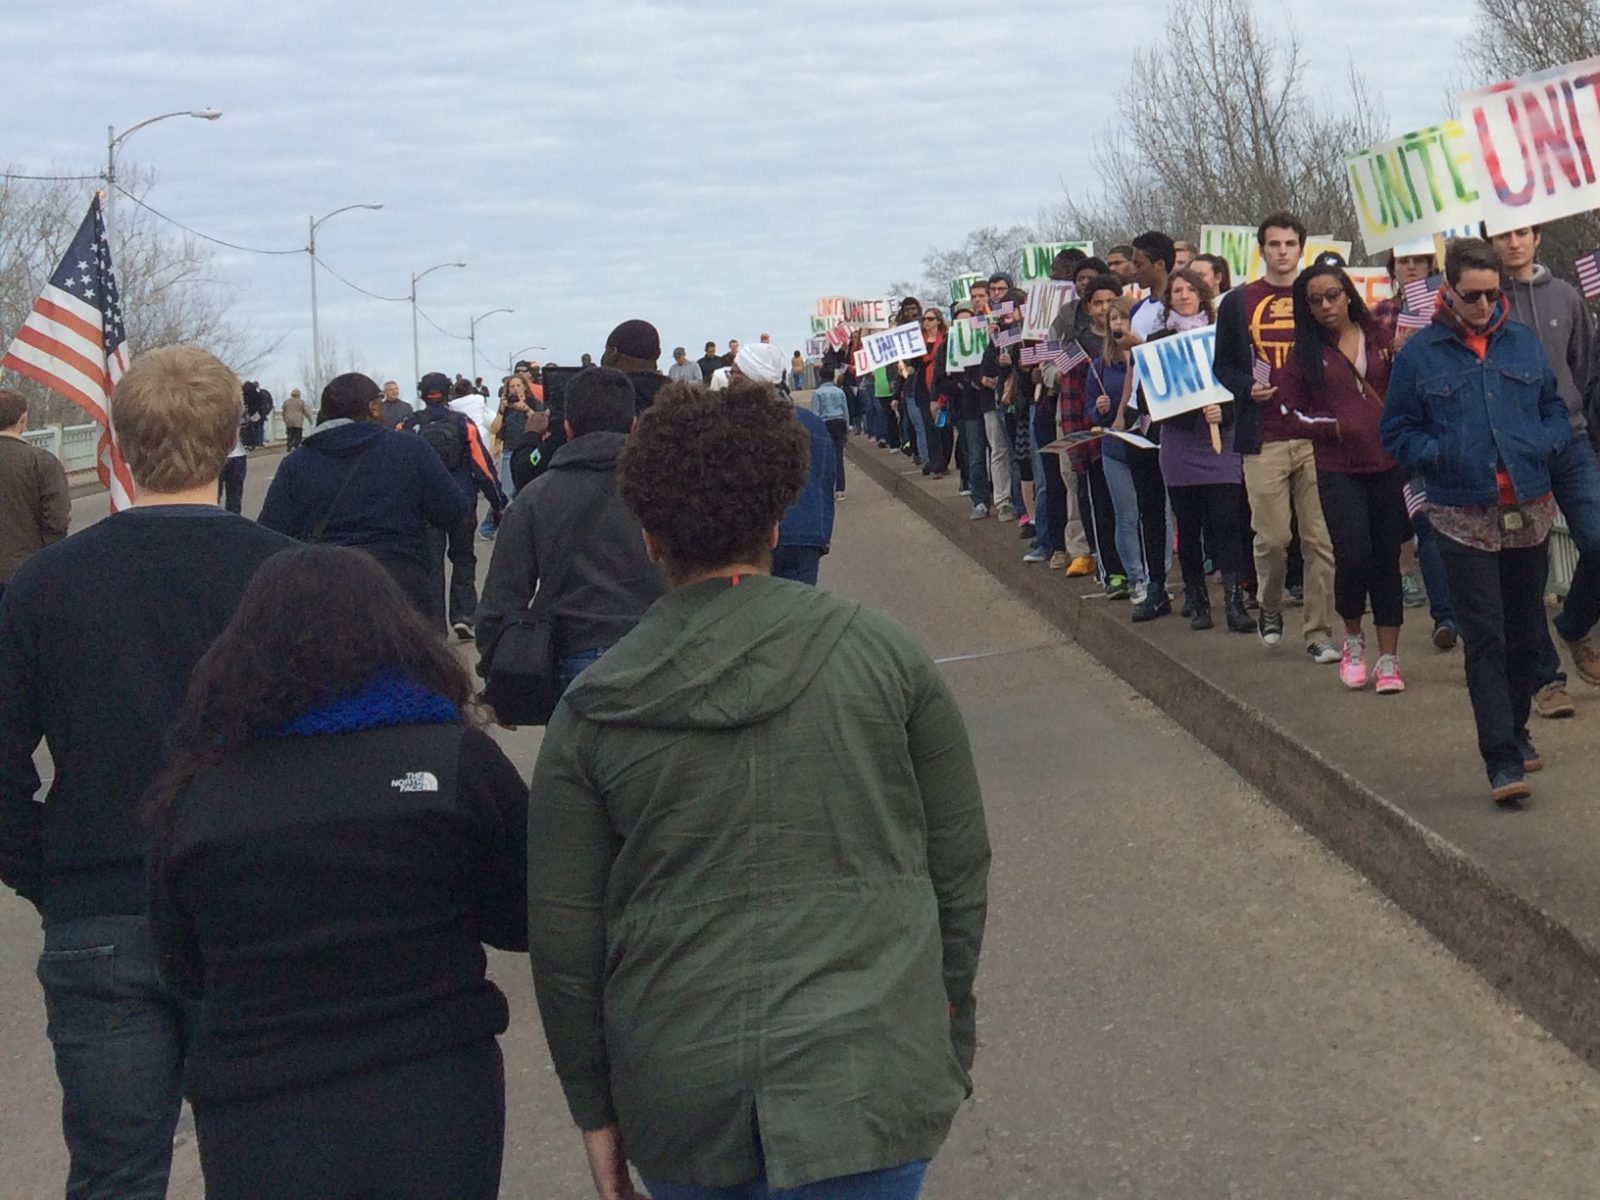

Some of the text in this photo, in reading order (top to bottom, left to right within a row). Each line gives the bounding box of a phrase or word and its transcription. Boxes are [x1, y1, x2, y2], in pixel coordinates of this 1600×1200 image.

[1350, 121, 1480, 236] UNITE
[949, 275, 983, 301] UNIT
[1028, 283, 1077, 331] UNIT
[842, 300, 886, 322] UNITE
[868, 327, 922, 364] UNITE
[1135, 330, 1222, 403] UNIT
